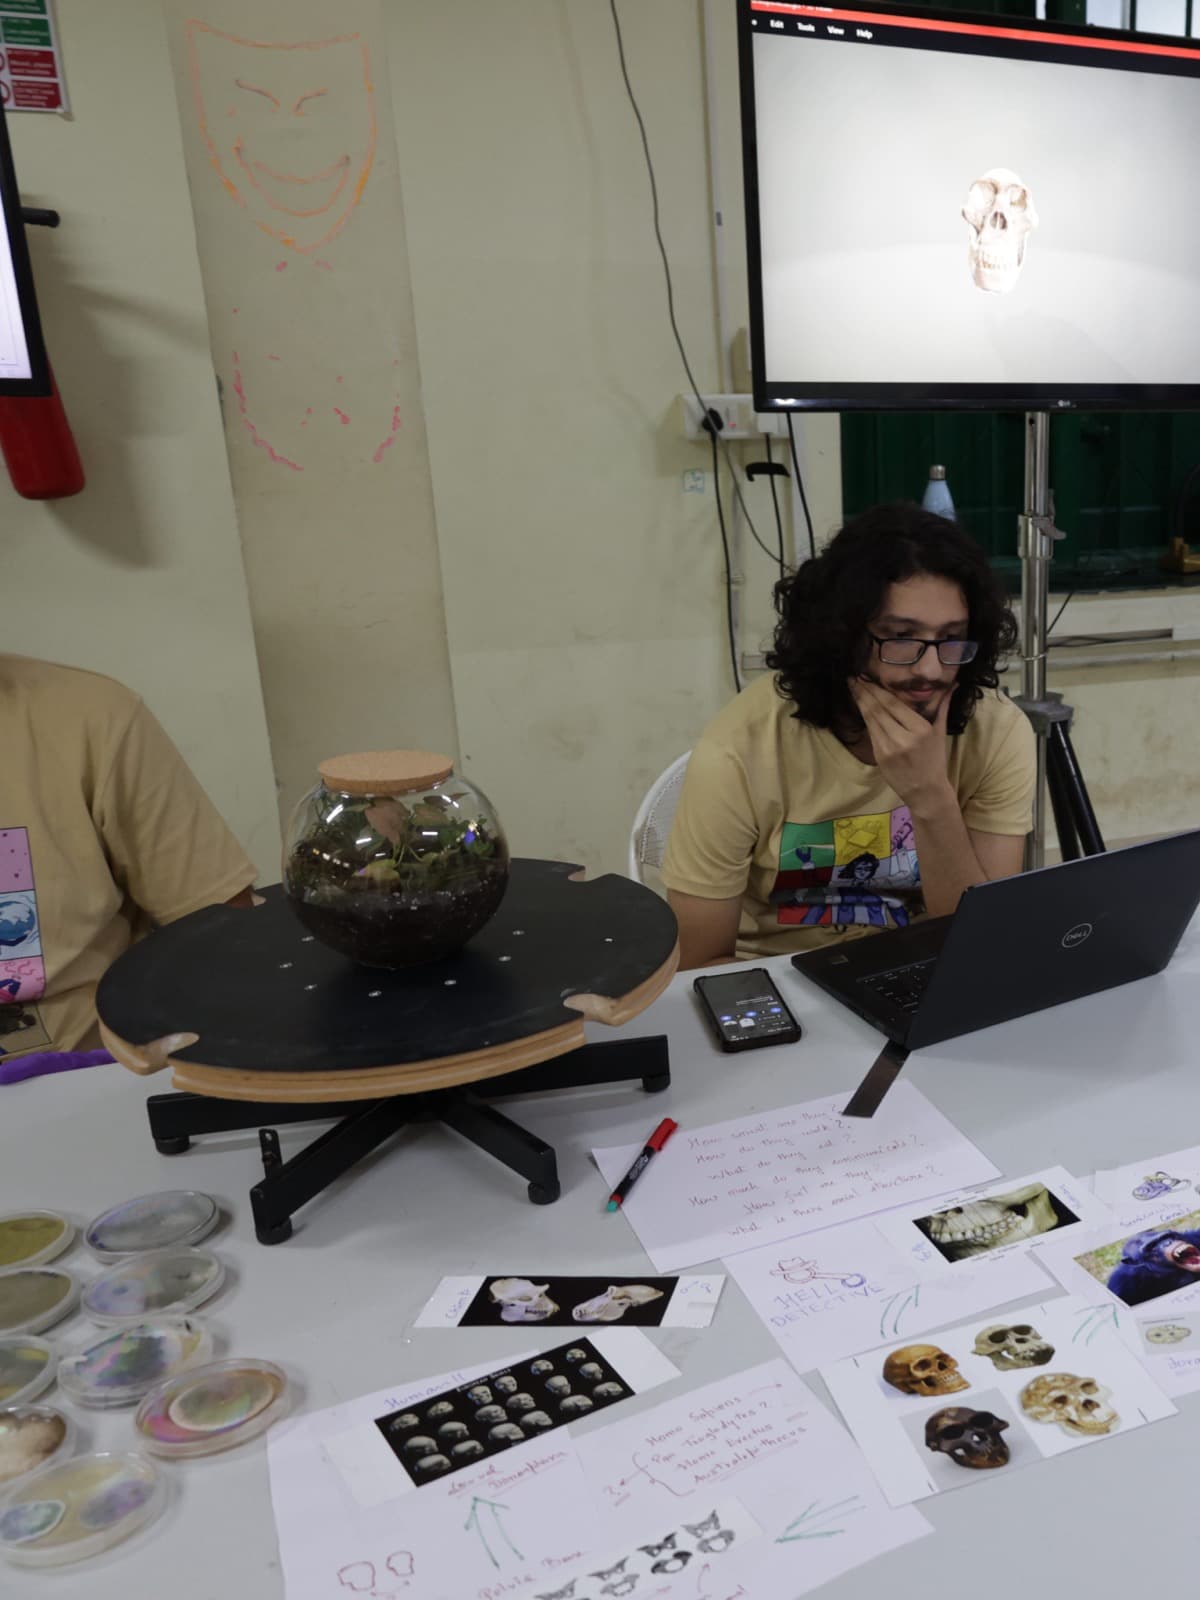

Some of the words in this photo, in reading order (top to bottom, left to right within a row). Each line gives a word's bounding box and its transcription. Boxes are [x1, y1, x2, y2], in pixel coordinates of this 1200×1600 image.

[695, 1149, 728, 1165] How
[760, 1135, 797, 1150] they
[777, 1149, 809, 1165] they
[687, 1192, 720, 1209] How
[795, 1164, 826, 1180] they
[770, 1285, 885, 1329] DETECTIVE
[645, 1424, 684, 1448] Homo
[688, 1396, 742, 1423] Sapiens
[676, 1449, 717, 1472] Homo
[726, 1423, 774, 1449] Erectus
